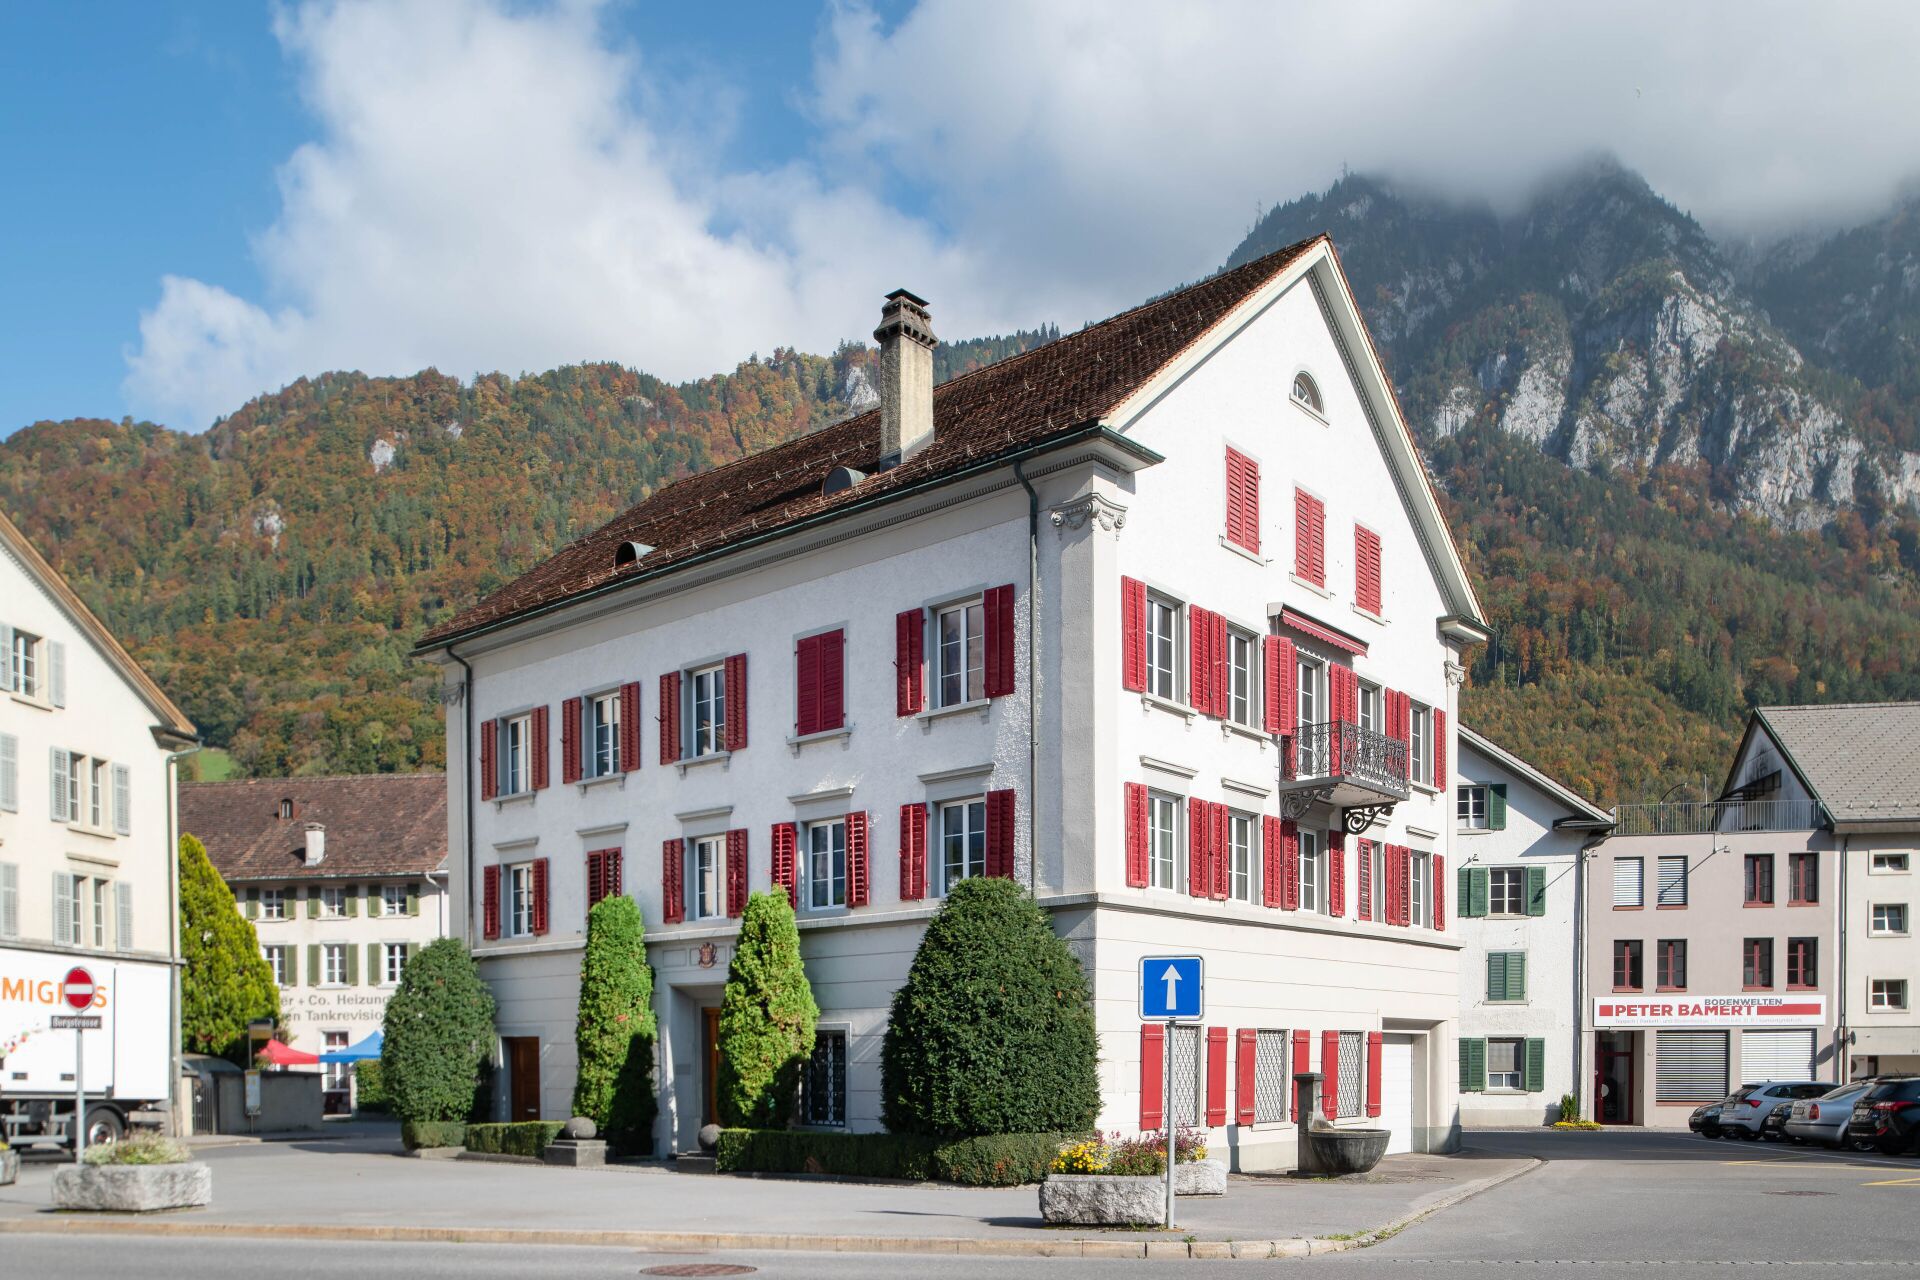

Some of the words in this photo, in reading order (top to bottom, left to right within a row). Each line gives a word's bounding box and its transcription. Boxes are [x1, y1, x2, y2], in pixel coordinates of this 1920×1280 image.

[2, 976, 107, 1008] MIGS
[308, 994, 330, 1006] Co.
[1704, 998, 1783, 1006] BODENWELTEN
[305, 1009, 385, 1021] Tankrevisio
[1615, 1005, 1673, 1017] PETER
[1677, 1005, 1755, 1017] BAMERT
